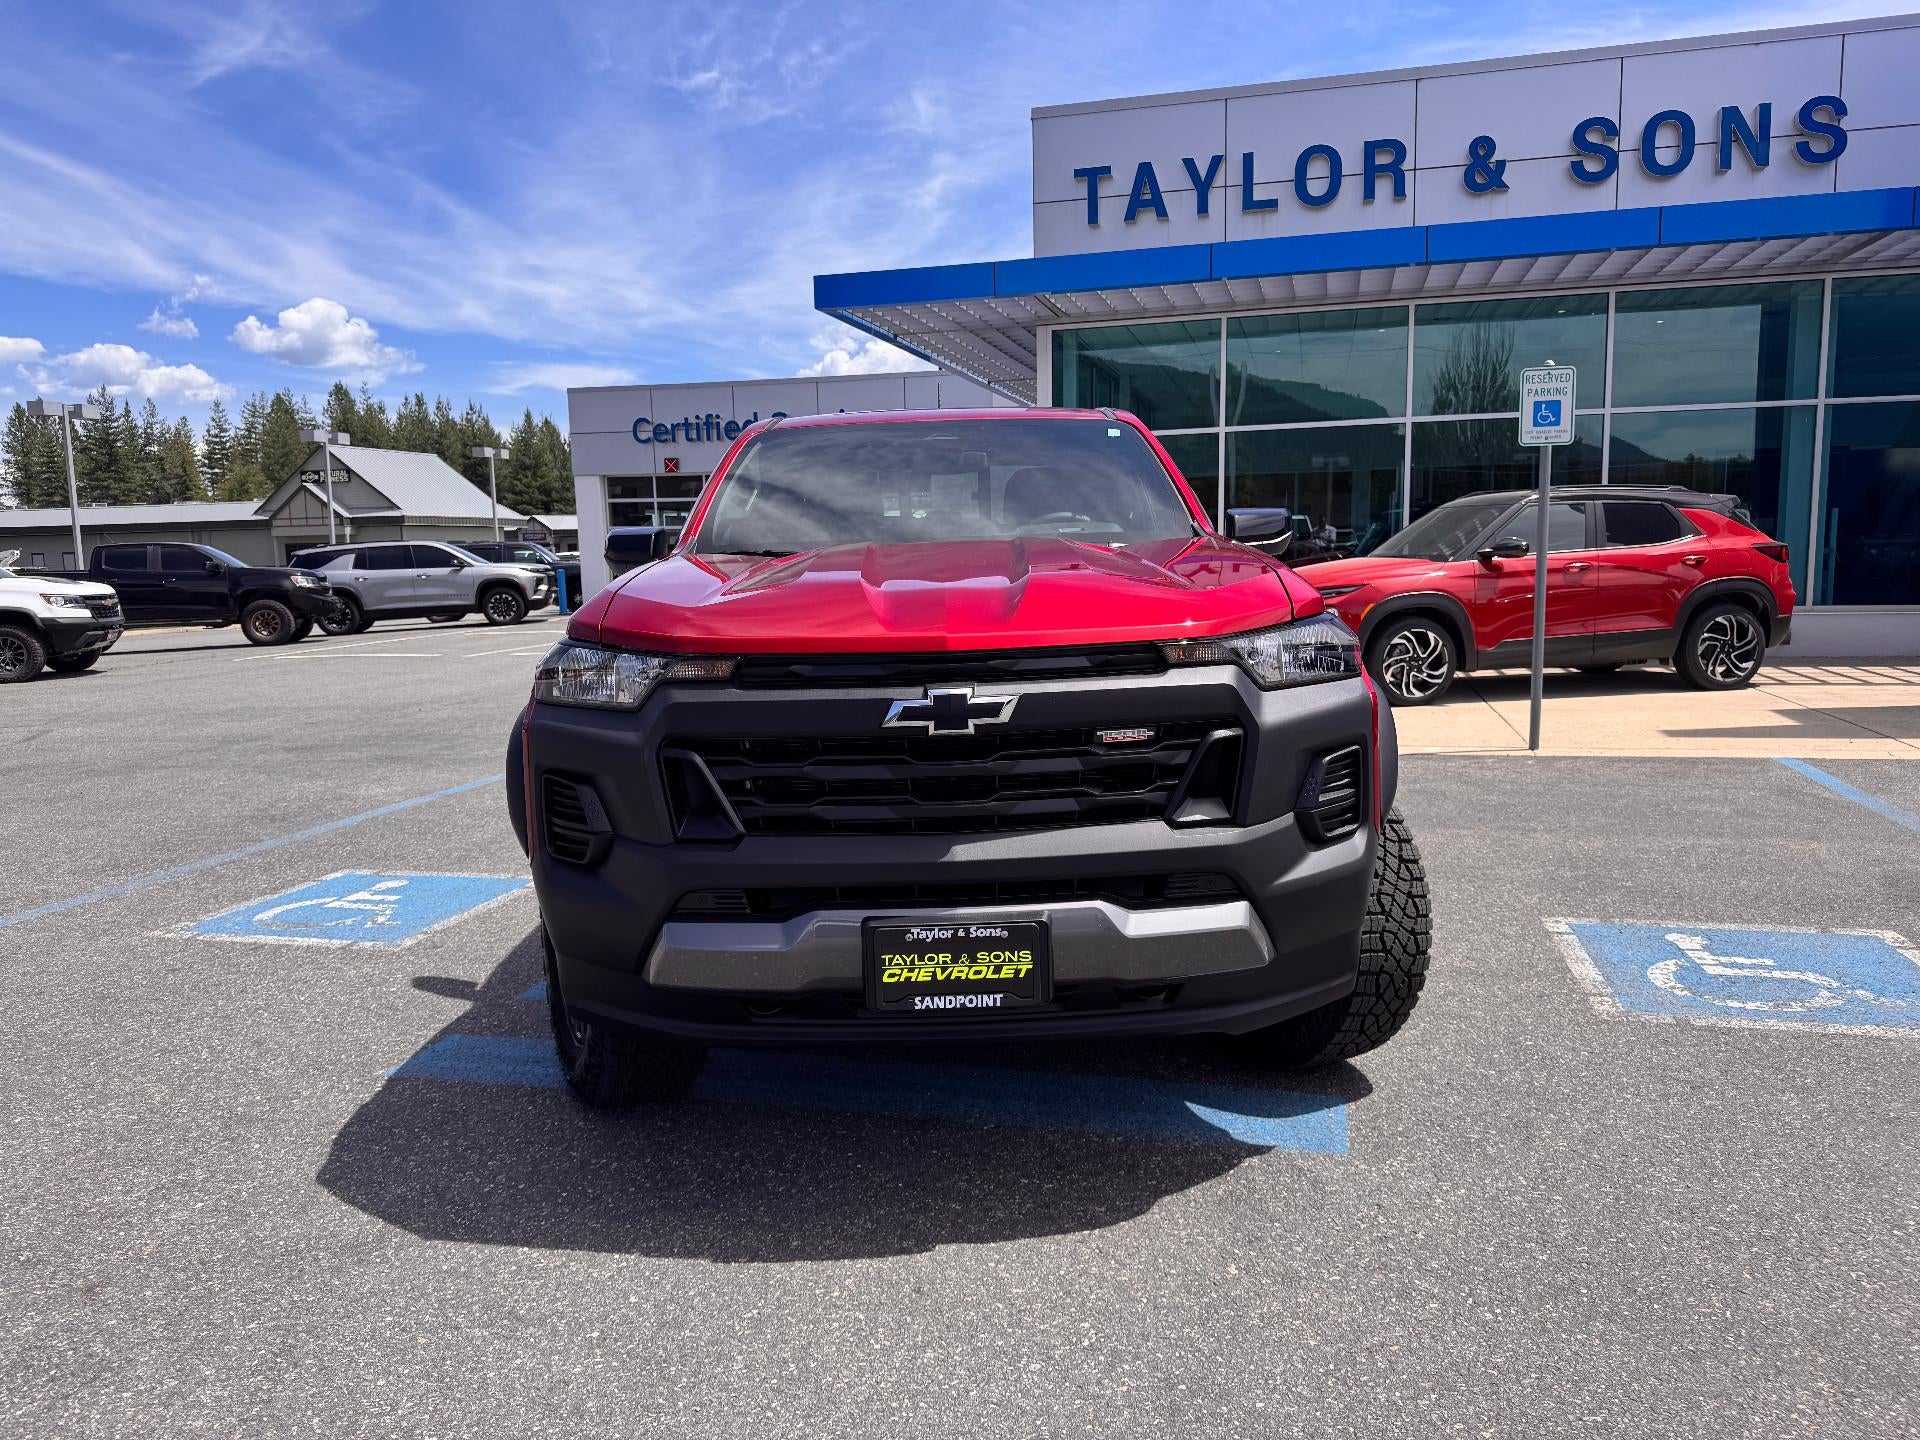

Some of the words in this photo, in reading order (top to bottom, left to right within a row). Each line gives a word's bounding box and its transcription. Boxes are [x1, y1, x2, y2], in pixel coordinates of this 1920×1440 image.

[1074, 138, 1408, 226] TAYLOR
[1463, 135, 1509, 195] &
[1570, 95, 1849, 185] SONS
[1525, 373, 1571, 384] RESERVED
[1527, 387, 1568, 397] PARKING
[911, 928, 954, 942] Taylor
[957, 929, 966, 937] &
[969, 927, 1002, 938] Sons
[881, 953, 952, 967] TAYLOR
[958, 953, 970, 966] &
[976, 950, 1032, 963] SONS
[882, 965, 1033, 983] CHEVROLET
[914, 993, 1003, 1010] SANDPOINT
